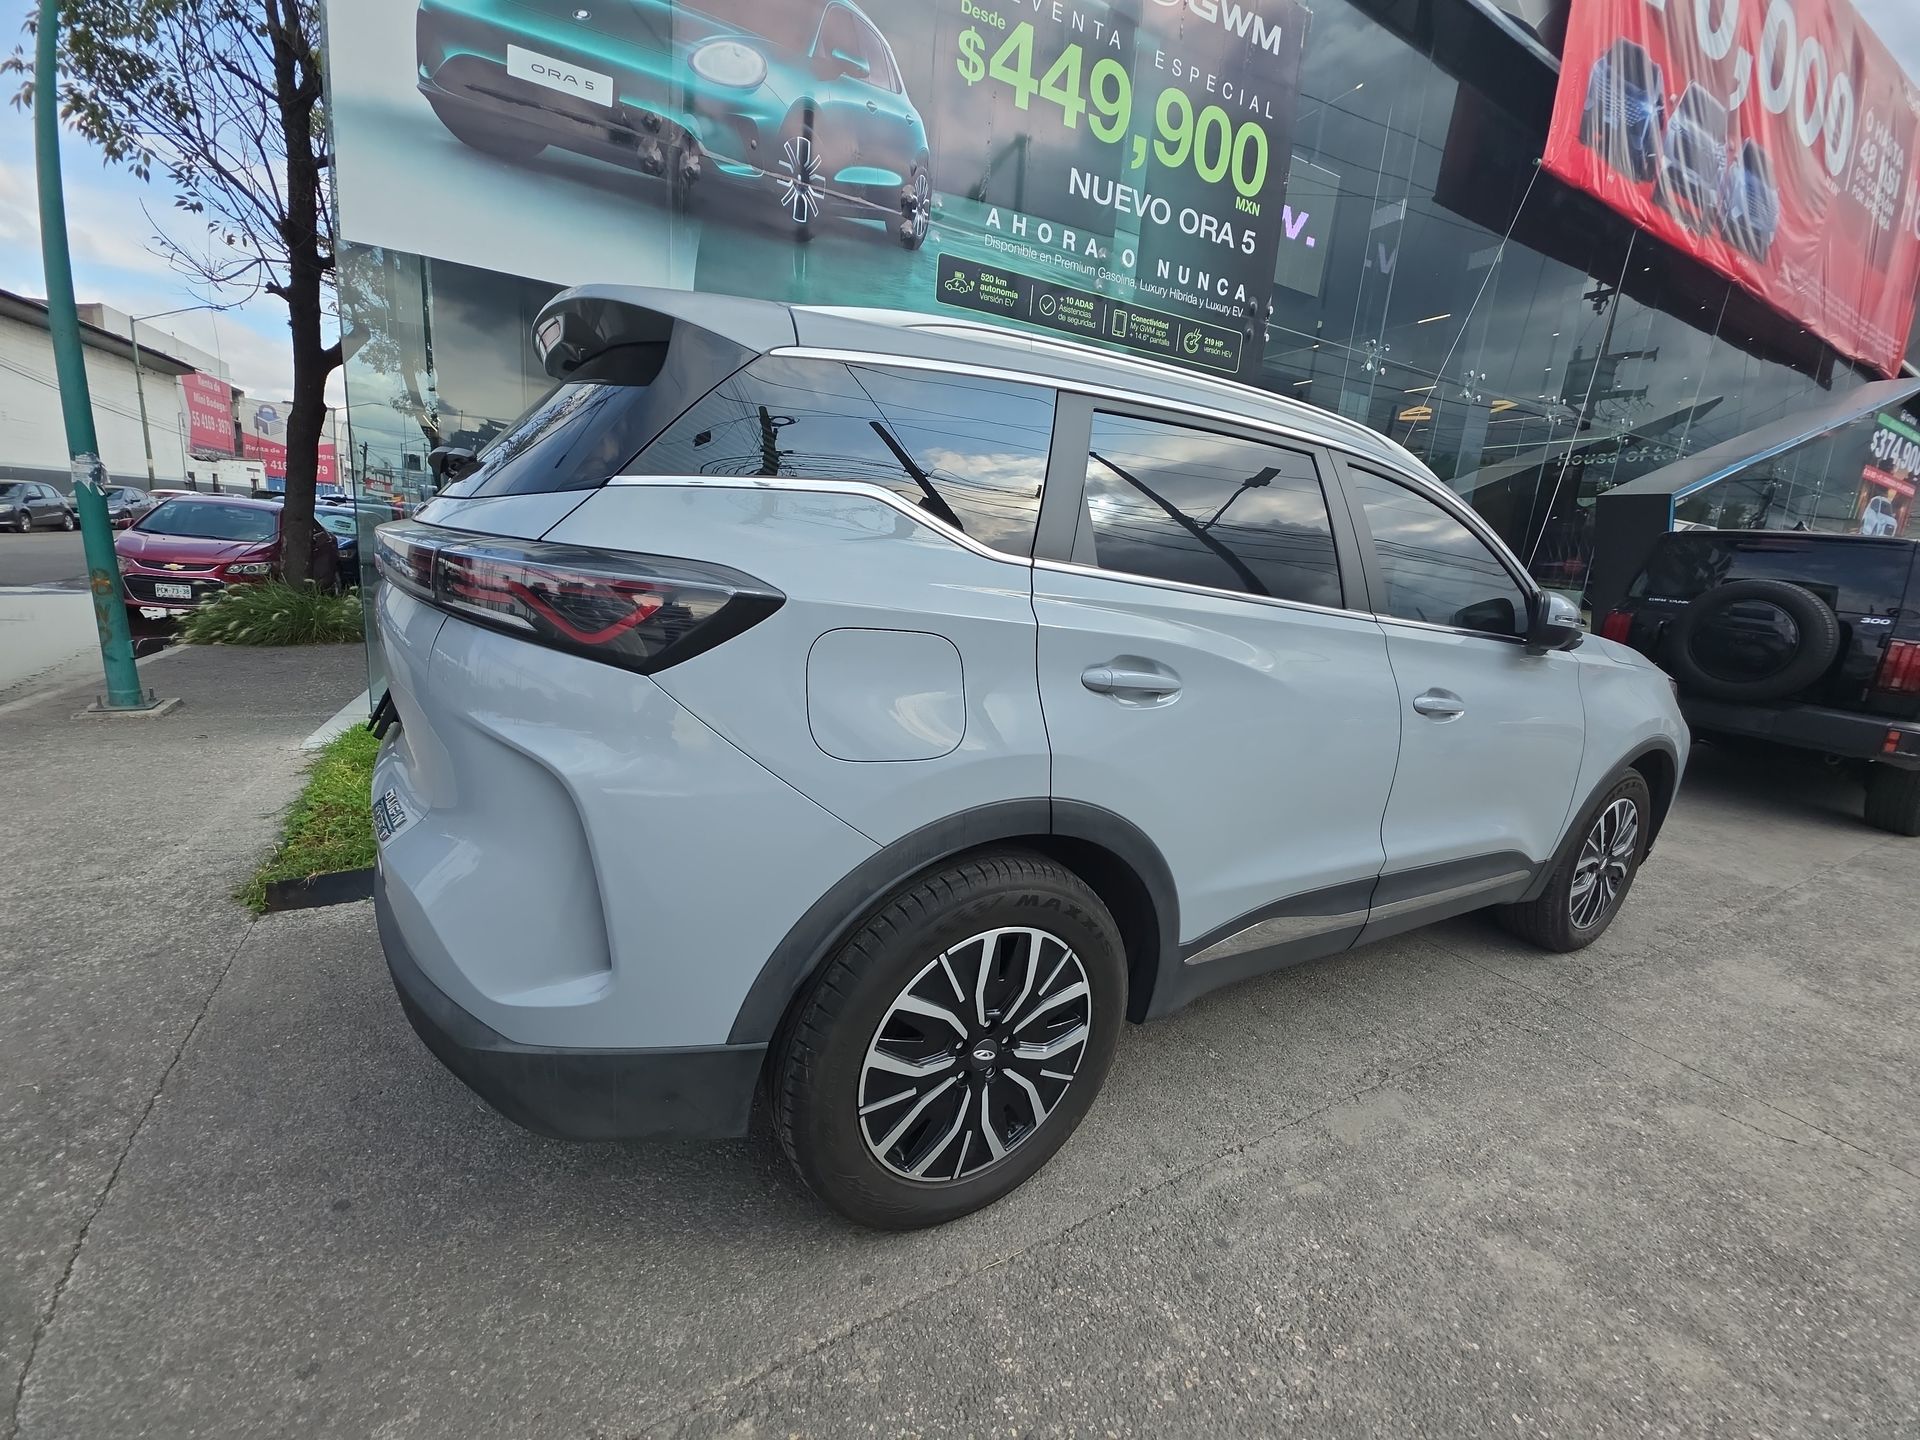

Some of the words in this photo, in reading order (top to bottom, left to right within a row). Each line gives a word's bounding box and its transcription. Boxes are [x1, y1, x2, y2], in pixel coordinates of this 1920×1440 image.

[961, 0, 1006, 30] Desde
[1188, 0, 1282, 56] GWM
[1012, 0, 1122, 50] VENTA
[1154, 49, 1274, 120] ESPECIAL
[531, 63, 578, 86] ORA
[585, 80, 595, 91] 5
[956, 21, 1269, 198] $449,900
[1860, 138, 1878, 173] 48
[1069, 167, 1171, 225] NUEVO
[1179, 207, 1235, 249] ORA
[1241, 229, 1257, 255] 5
[1235, 195, 1261, 217] MXN
[985, 207, 1098, 259] AHORA
[1122, 248, 1135, 268] O
[1157, 258, 1246, 303] NUNCA
[980, 272, 994, 283] 520
[995, 275, 1007, 287] km
[984, 233, 1037, 260] Disponible
[1040, 252, 1052, 263] en
[1054, 254, 1096, 277] Premium
[1098, 266, 1137, 289] Gasolina,
[1140, 278, 1168, 299] Luxury
[1199, 298, 1205, 309] y
[1205, 299, 1232, 316] Luxury
[1232, 306, 1244, 318] EV
[979, 291, 1004, 306] Versión
[1004, 299, 1015, 308] EV
[980, 282, 1019, 299] autonomía
[1059, 303, 1092, 319] Asistencias
[1066, 296, 1074, 305] 10
[1075, 298, 1094, 310] ADAS
[1057, 313, 1066, 322] de
[1067, 316, 1097, 329] seguridad
[1131, 313, 1169, 330] Conectividad
[1215, 339, 1224, 348] HP
[192, 410, 200, 427] 55
[1860, 617, 1891, 625] 300
